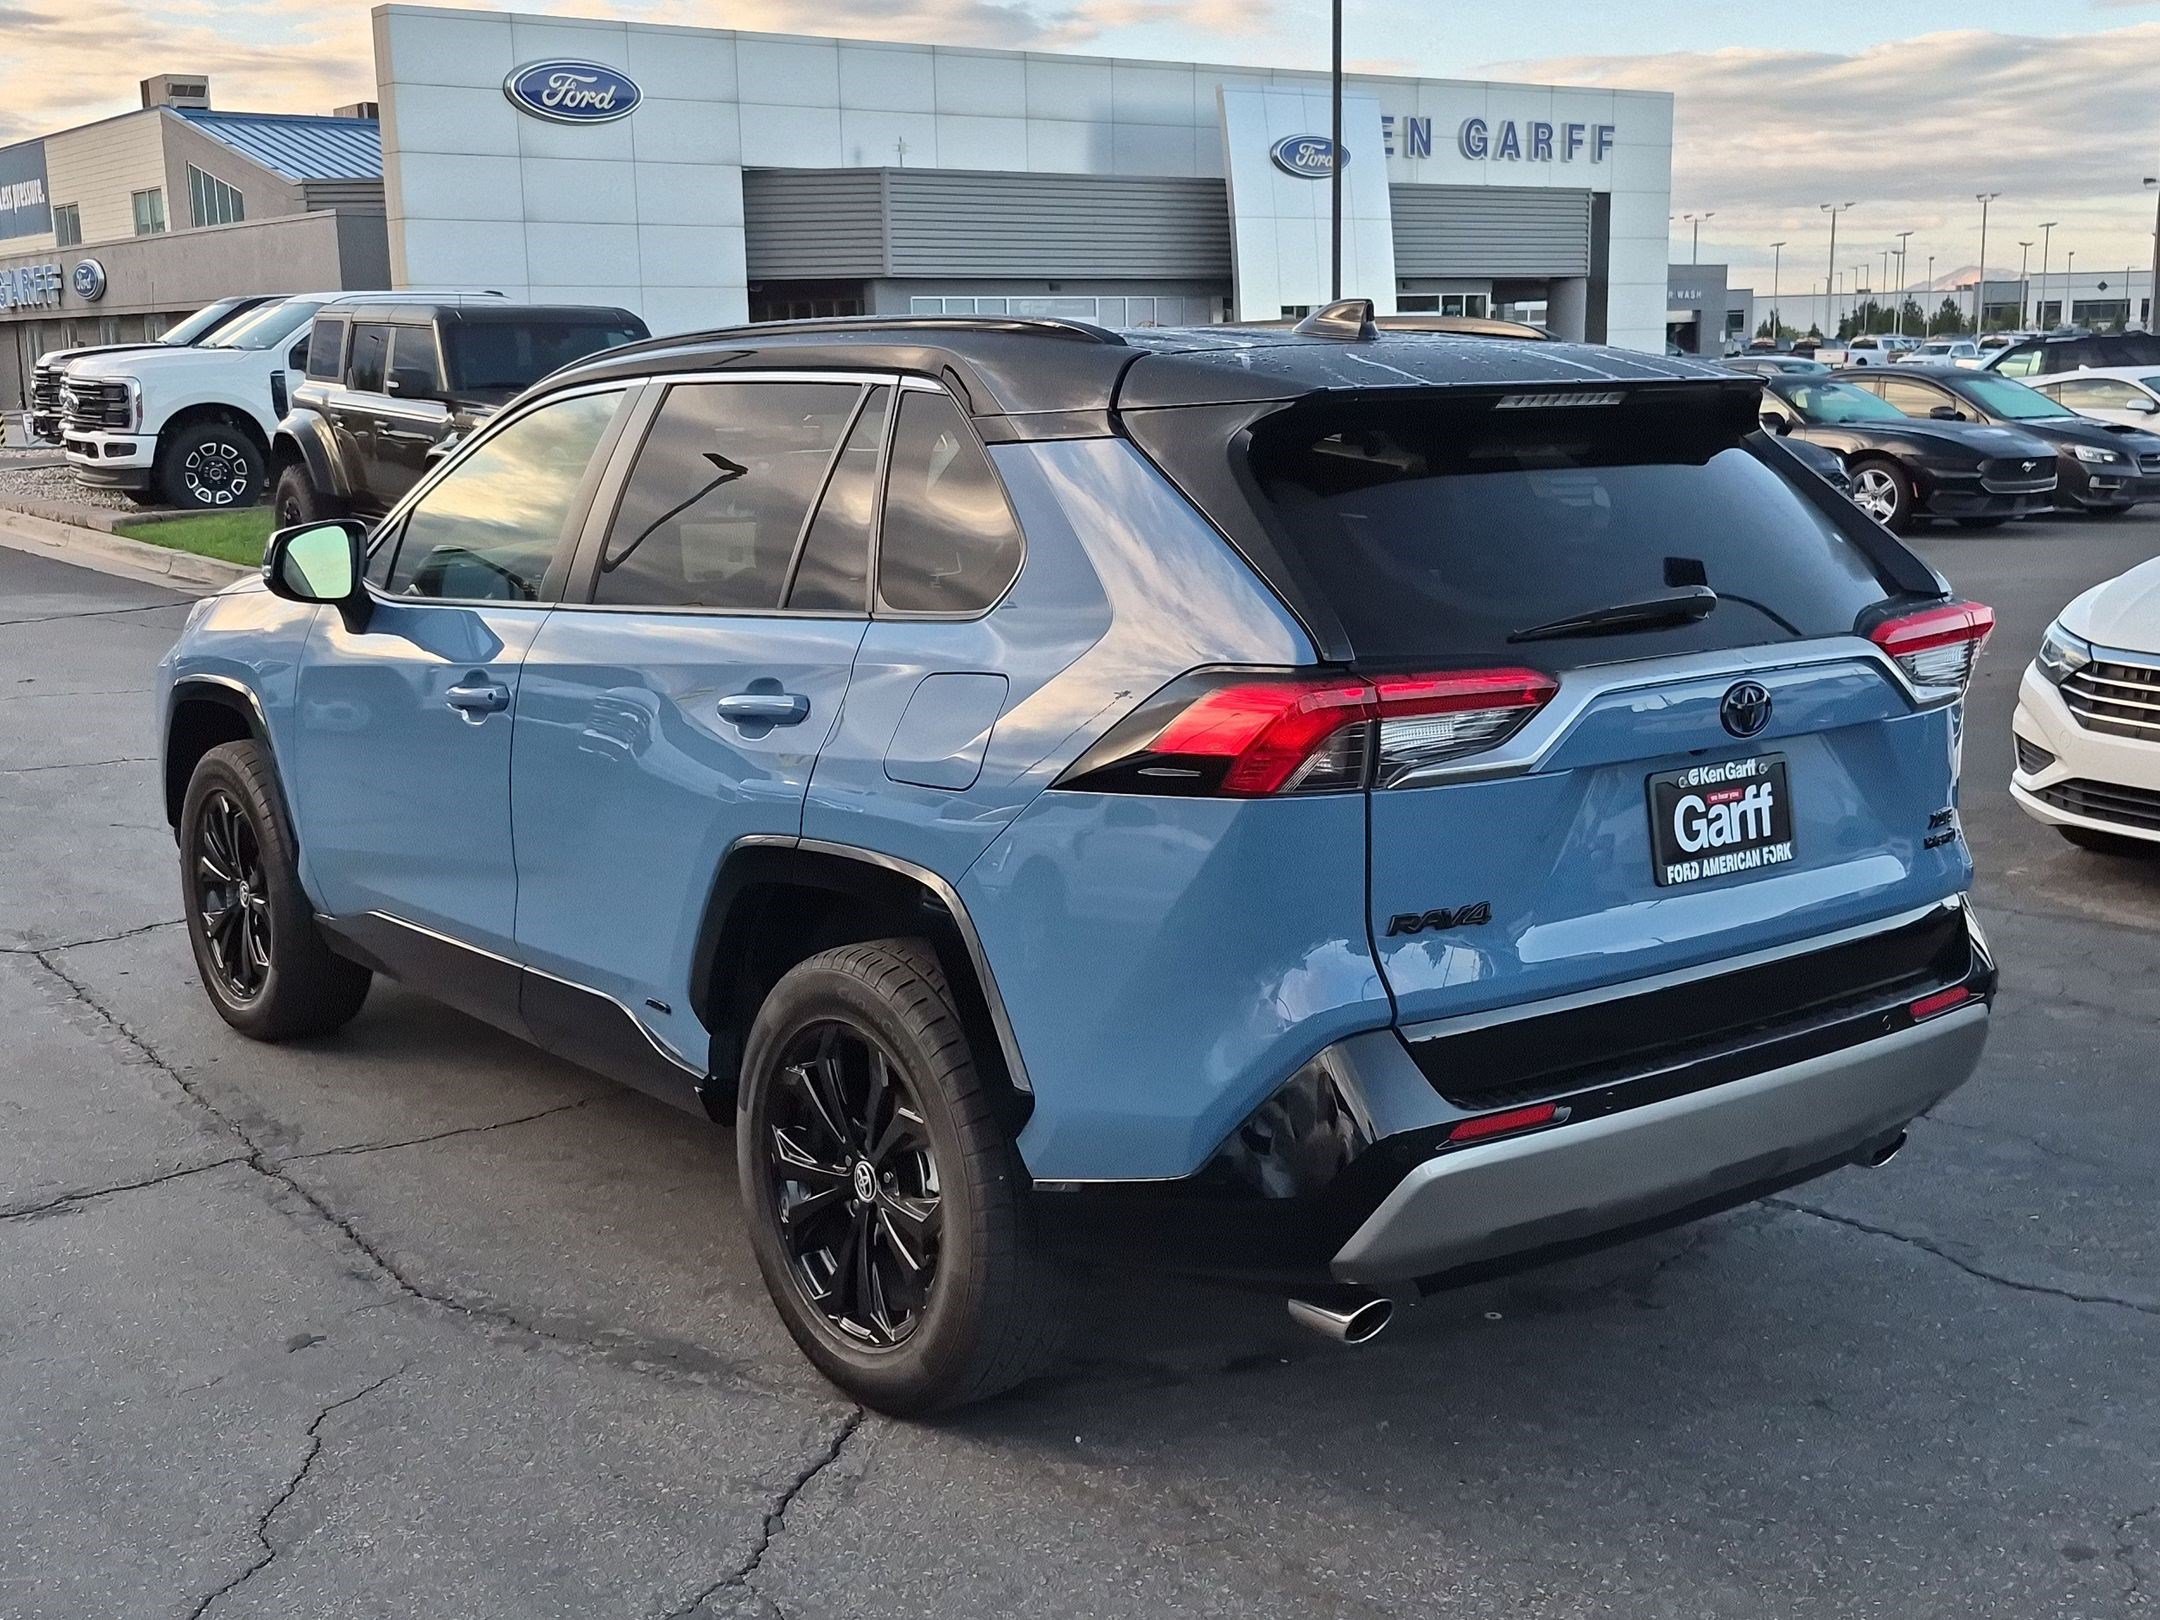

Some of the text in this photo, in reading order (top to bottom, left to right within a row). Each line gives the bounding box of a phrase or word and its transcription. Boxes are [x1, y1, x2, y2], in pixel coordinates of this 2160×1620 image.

[541, 72, 618, 110] Ford
[1381, 115, 1616, 163] EN GARFF
[1677, 290, 1702, 299] WASH
[1674, 782, 1773, 853] Garff
[1667, 841, 1793, 884] FORD AMERICAN FORK
[1386, 901, 1492, 937] RAV4
